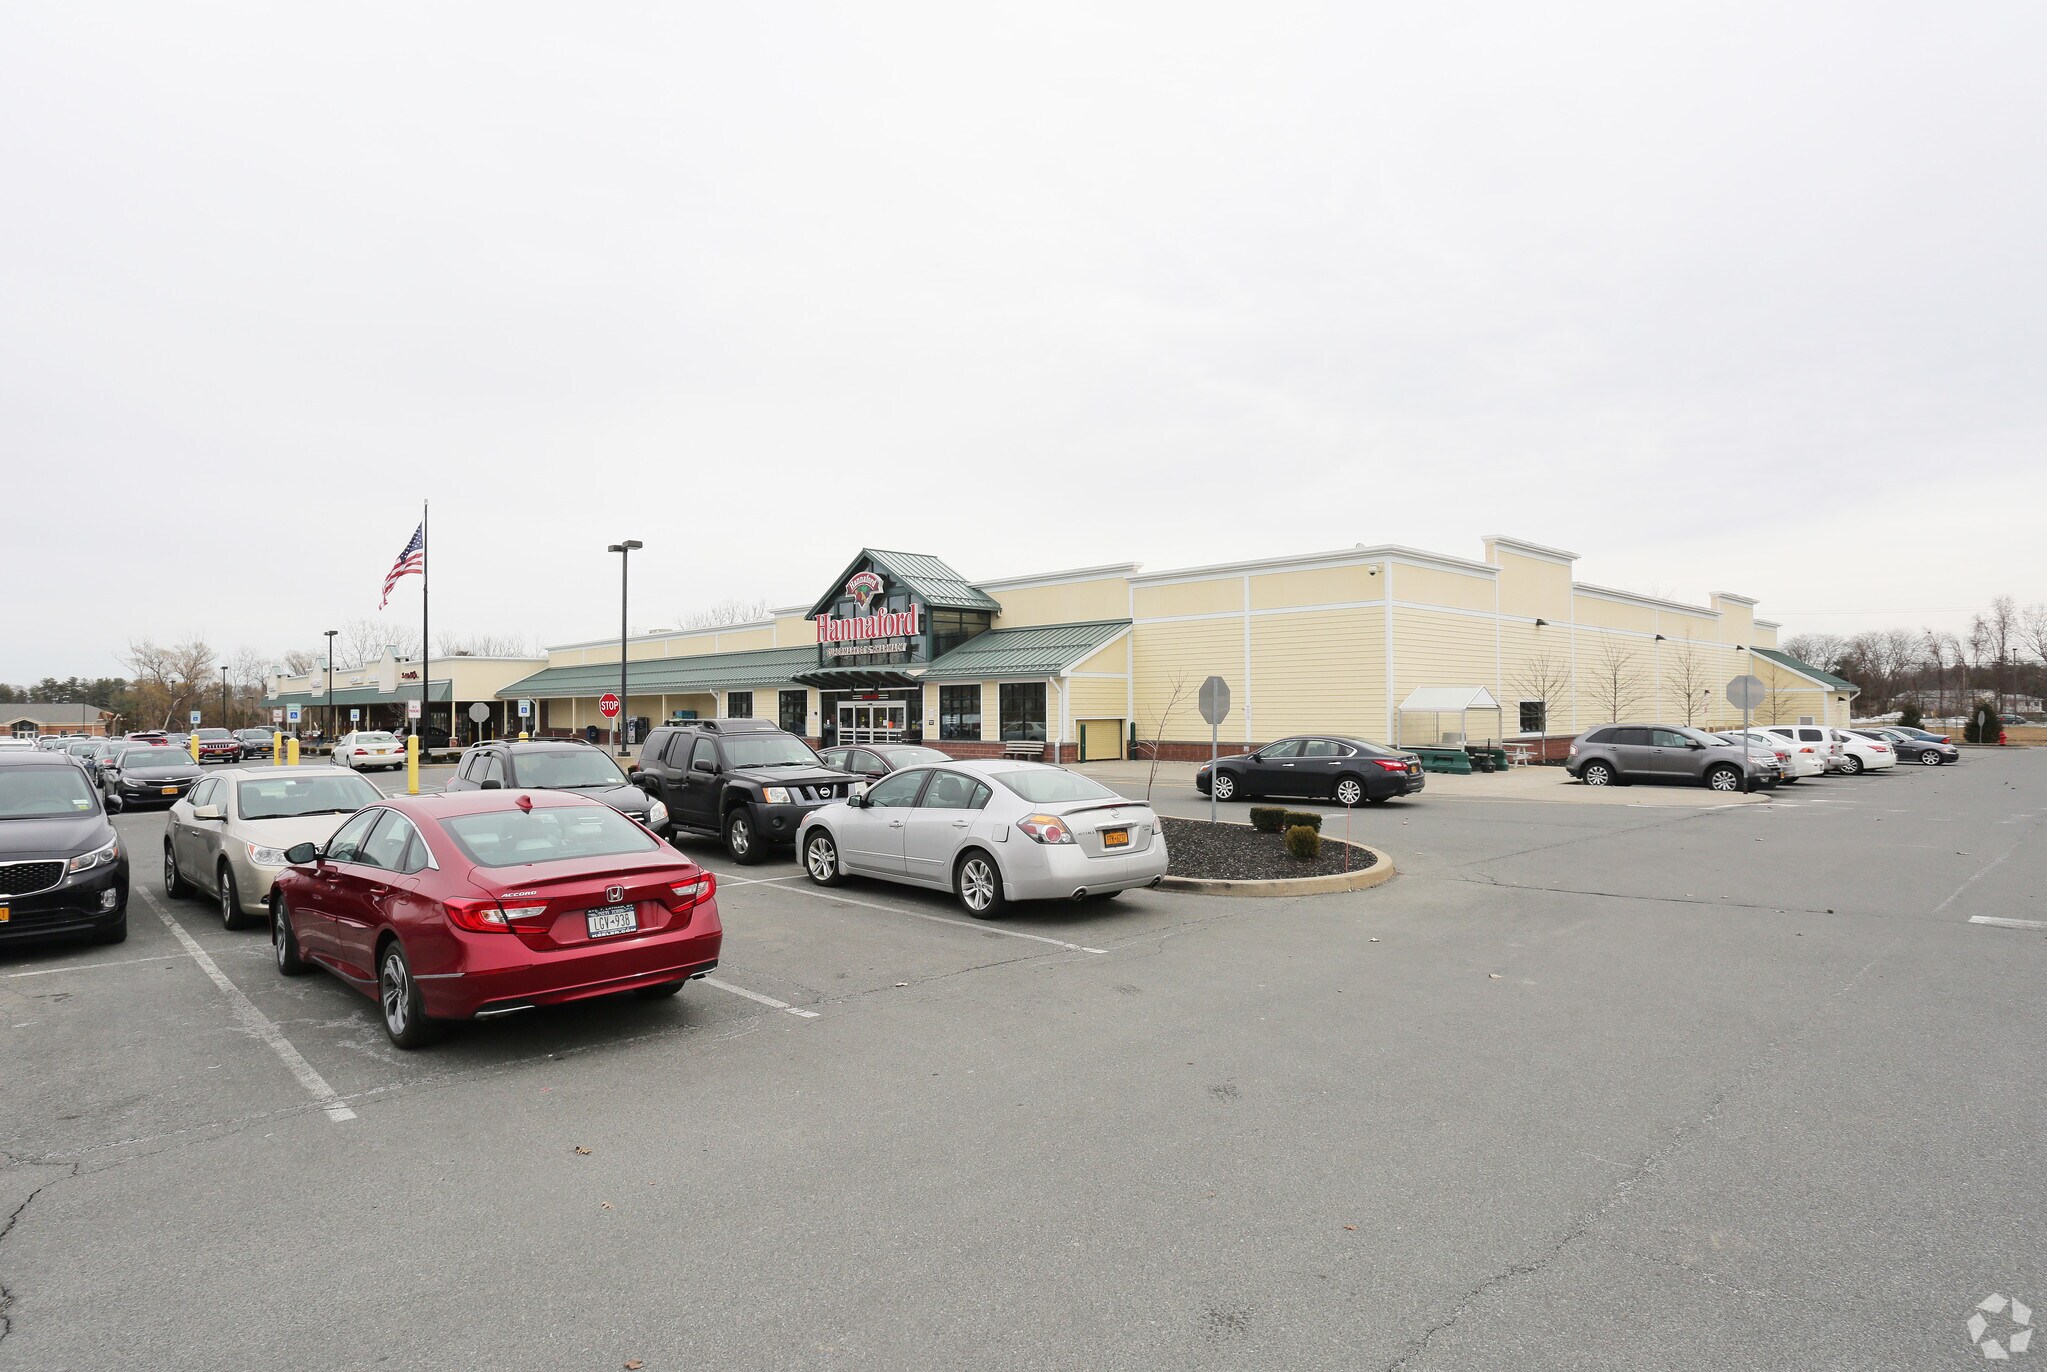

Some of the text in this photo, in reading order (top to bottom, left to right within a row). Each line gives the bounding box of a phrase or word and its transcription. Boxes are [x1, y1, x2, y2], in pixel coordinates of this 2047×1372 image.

[850, 574, 877, 590] Hannaford
[815, 603, 919, 643] Hannaford
[601, 701, 618, 710] STOP
[501, 890, 537, 898] ACCORD
